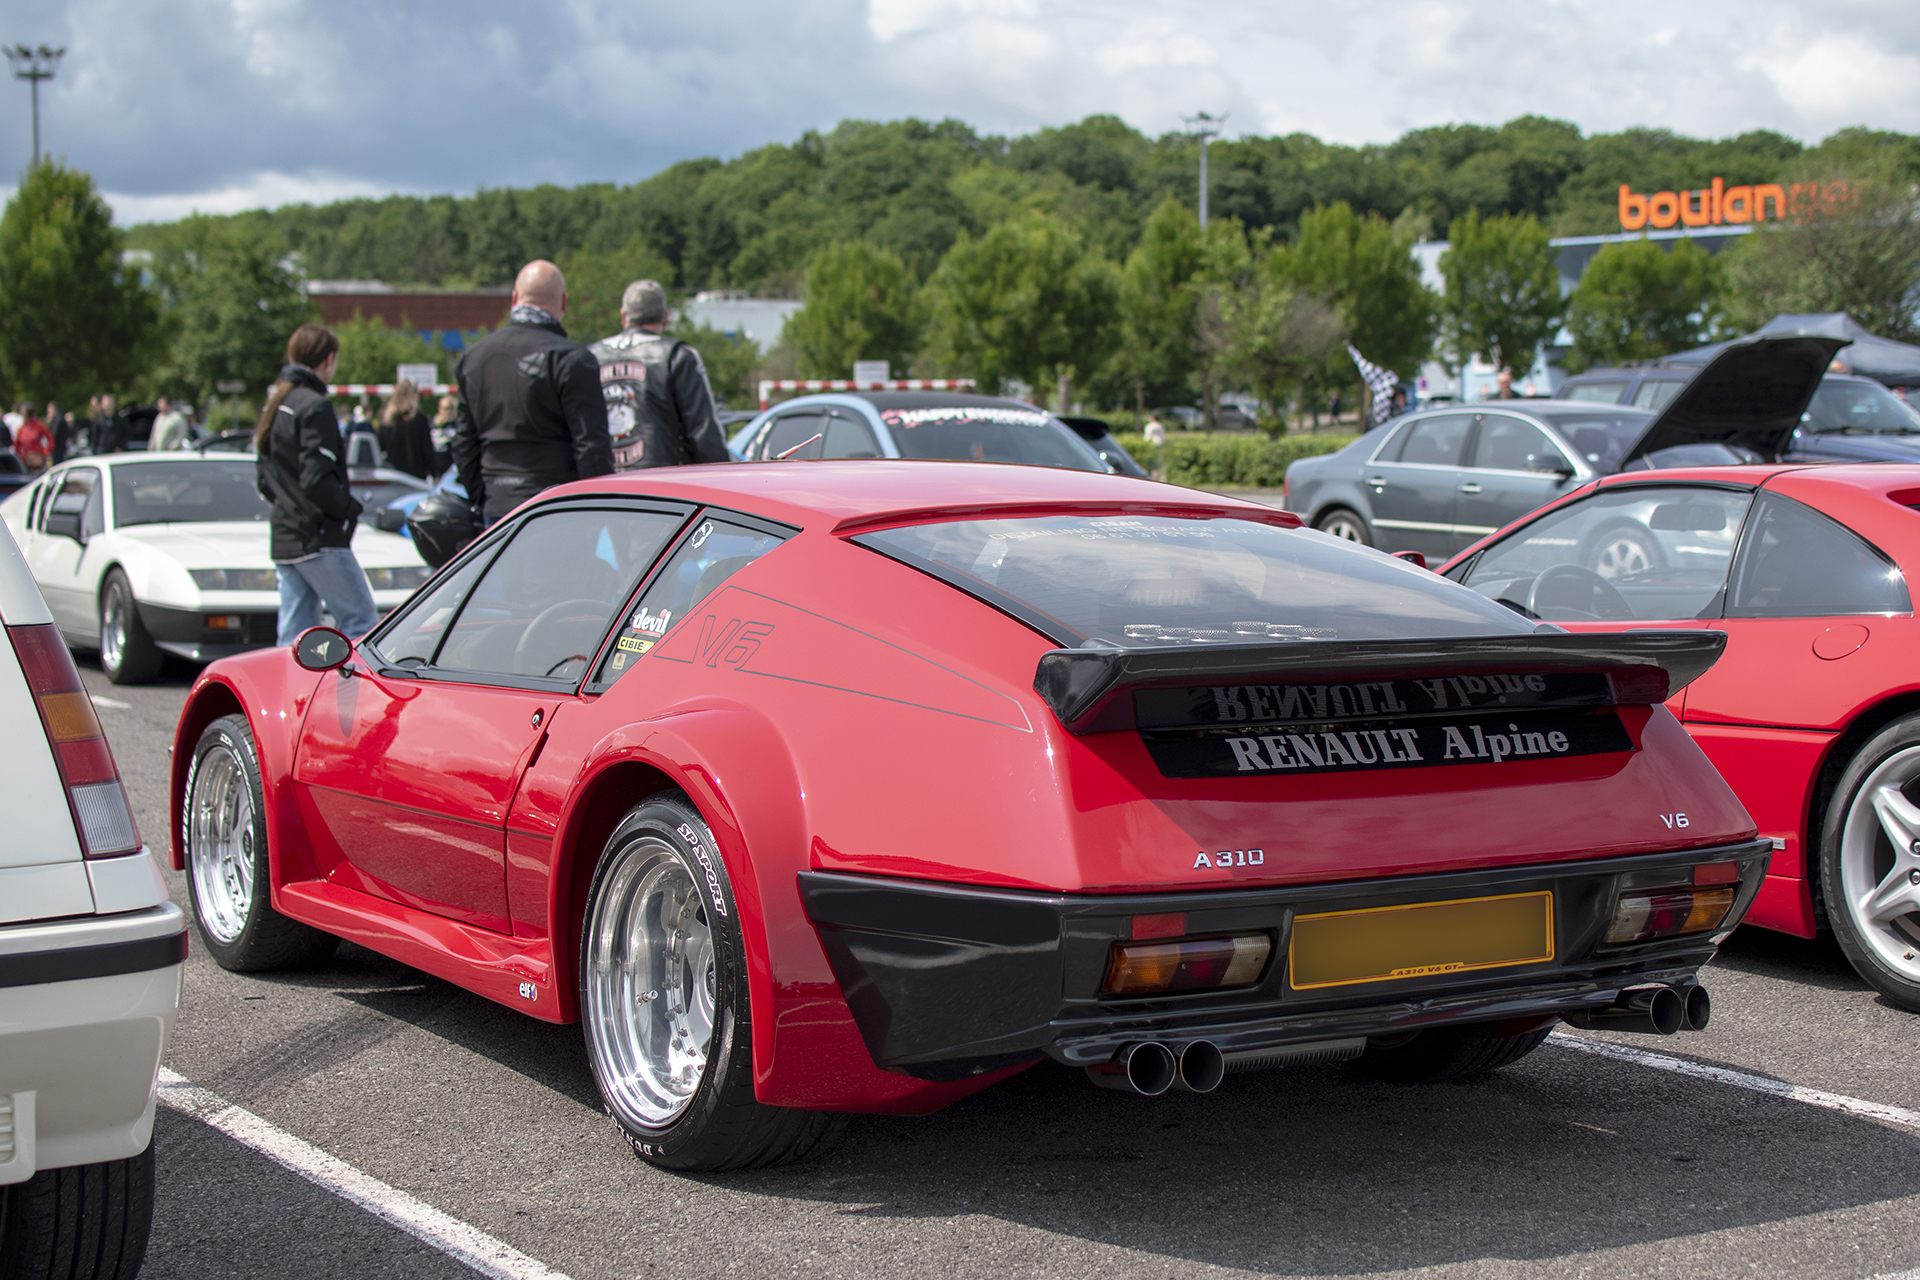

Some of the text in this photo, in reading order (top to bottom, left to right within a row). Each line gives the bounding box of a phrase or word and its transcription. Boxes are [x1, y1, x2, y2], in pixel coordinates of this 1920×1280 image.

[1618, 176, 1862, 231] boulan
[988, 527, 1098, 540] DETAILING
[1130, 588, 1210, 606] ALPINE
[632, 607, 672, 635] devil
[619, 638, 644, 651] CIBIE
[692, 614, 775, 670] V6
[1225, 722, 1570, 771] RENAULT Alpine
[1659, 812, 1690, 829] V6
[677, 823, 699, 846] SP
[692, 844, 728, 917] SPORT
[1395, 968, 1425, 977] A310
[1444, 963, 1460, 971] GT
[519, 981, 532, 1000] elf
